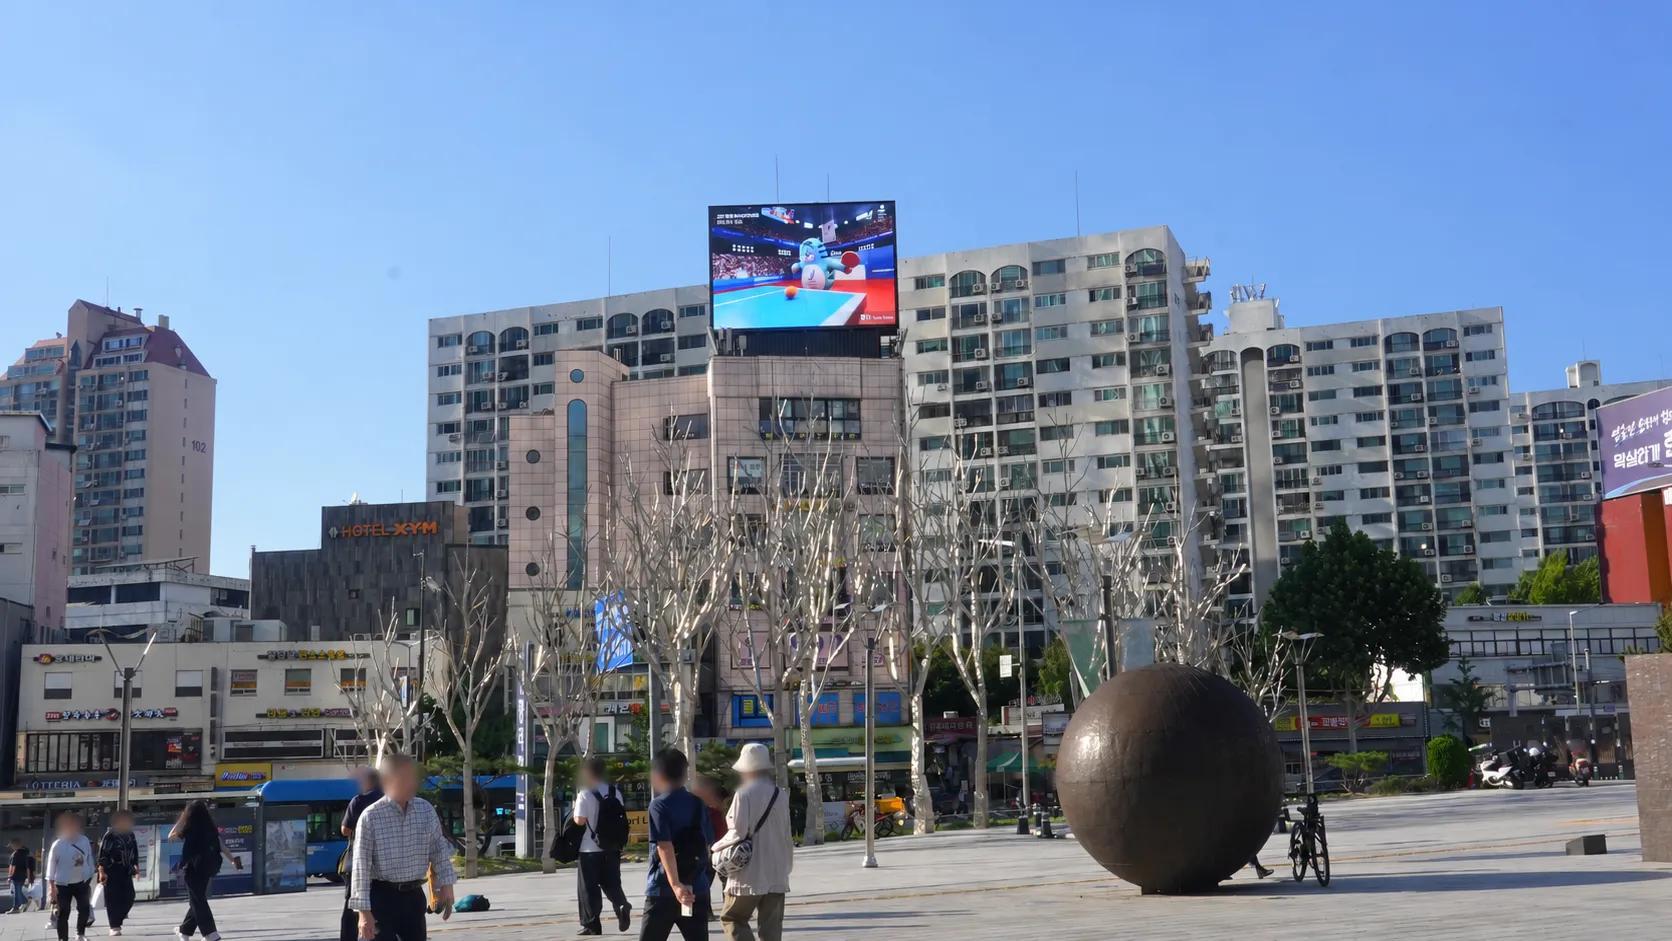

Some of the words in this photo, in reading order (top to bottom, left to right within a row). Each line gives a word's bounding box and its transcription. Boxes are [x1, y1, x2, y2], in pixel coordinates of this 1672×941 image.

[191, 440, 206, 453] 102
[342, 524, 390, 537] HOTEL
[393, 522, 437, 535] XYM
